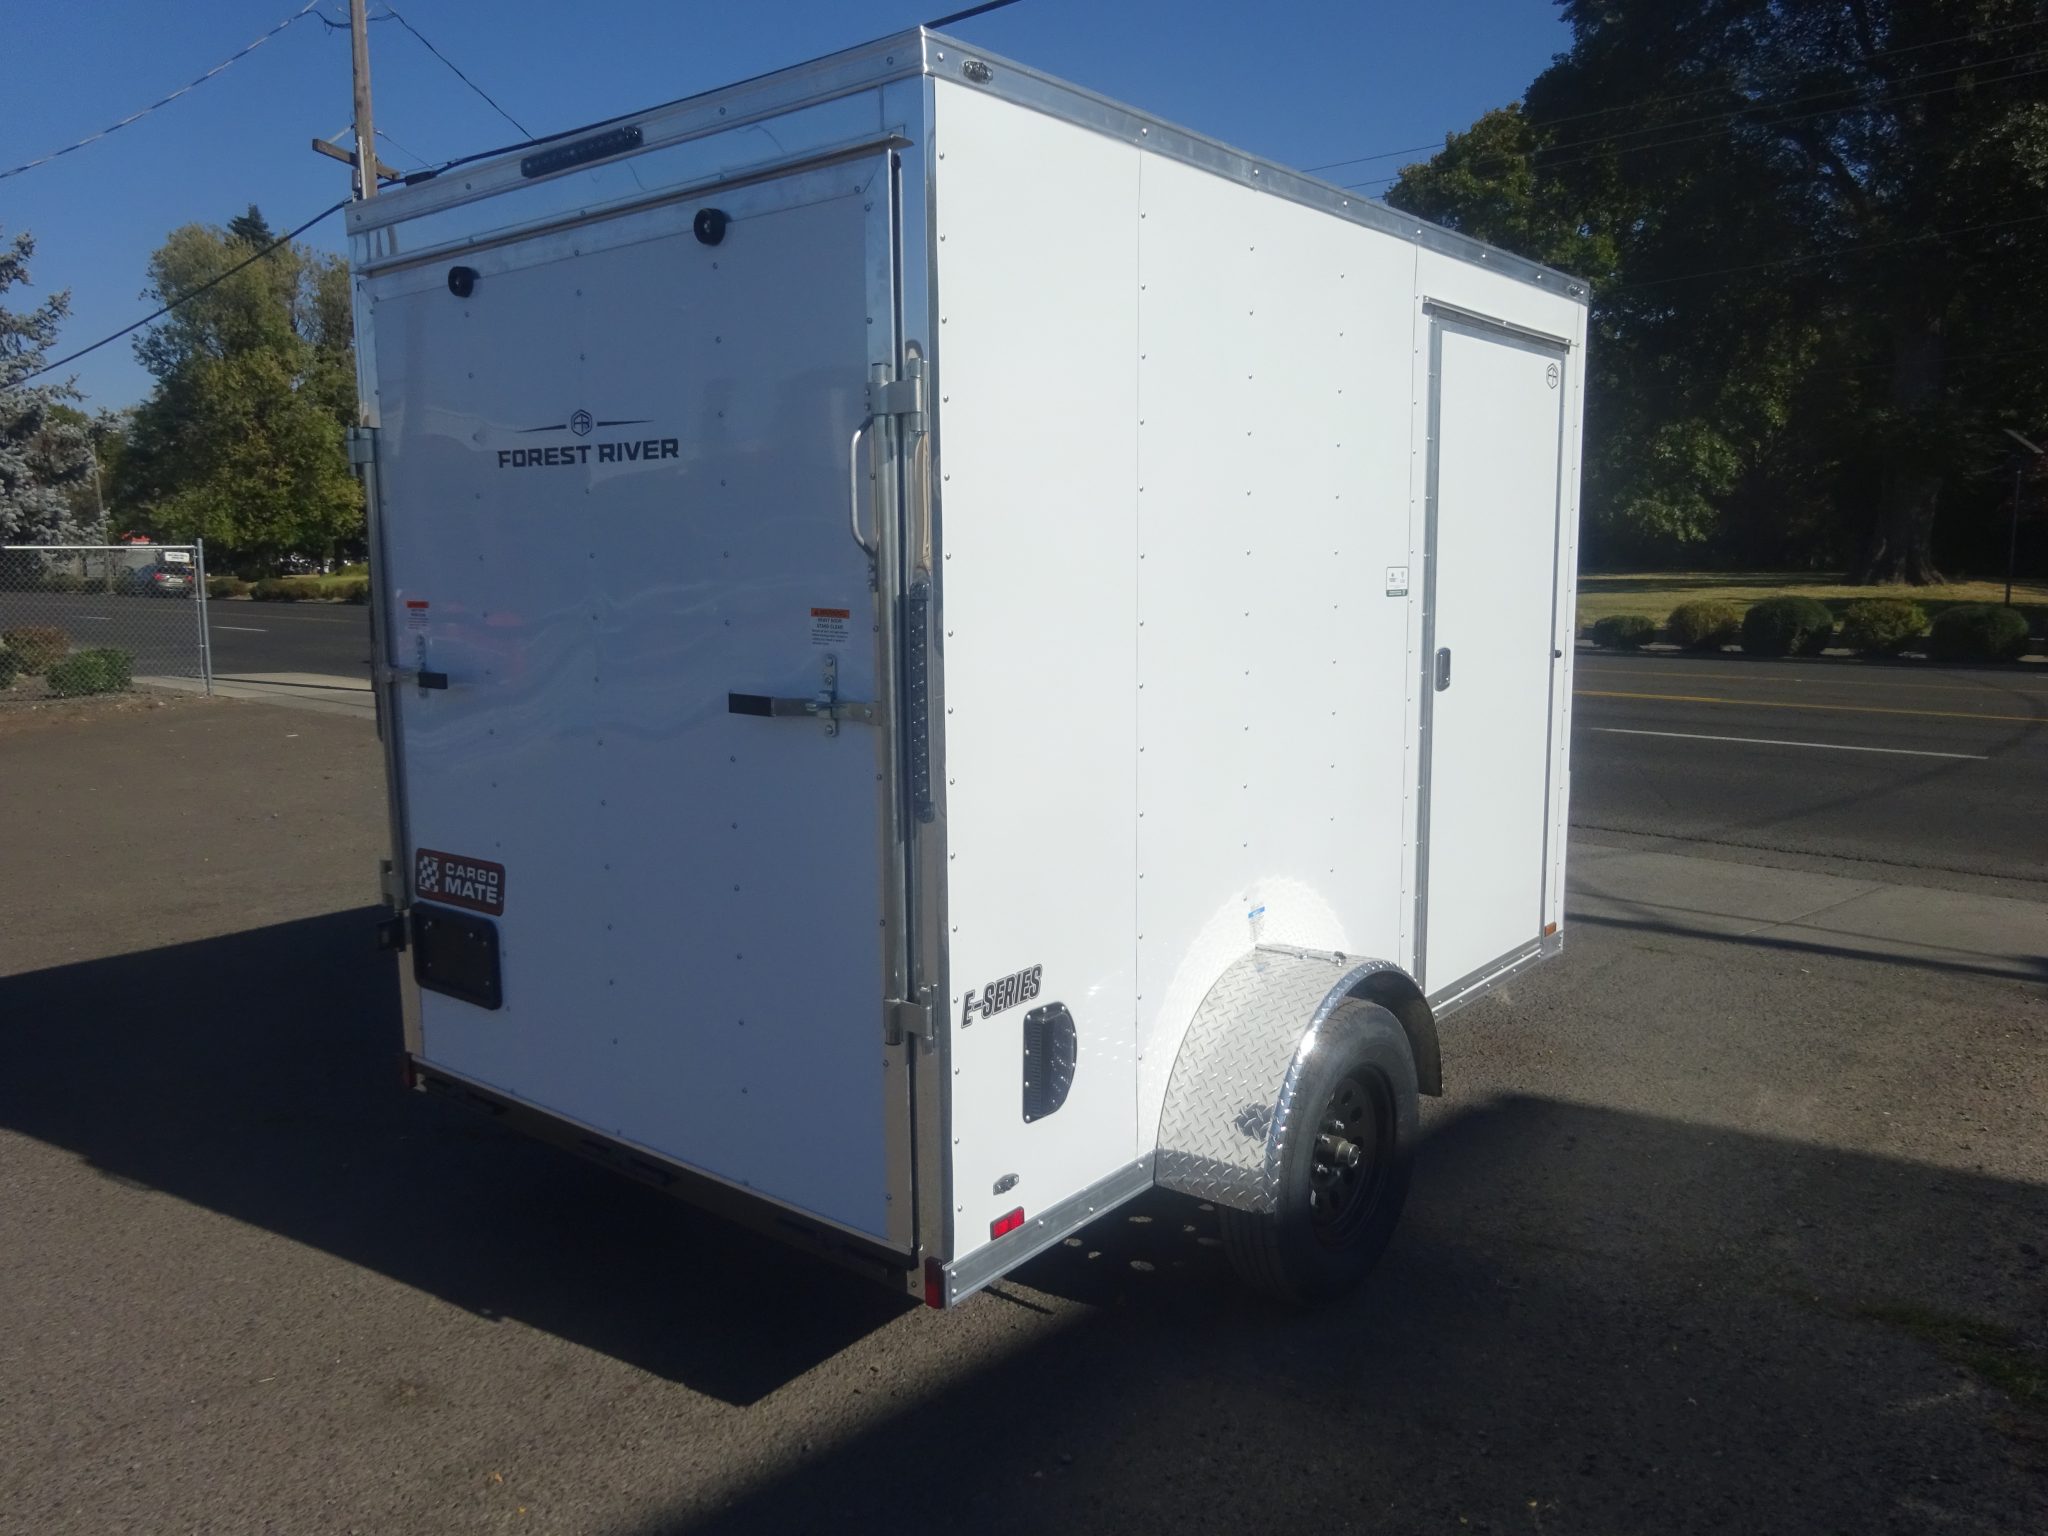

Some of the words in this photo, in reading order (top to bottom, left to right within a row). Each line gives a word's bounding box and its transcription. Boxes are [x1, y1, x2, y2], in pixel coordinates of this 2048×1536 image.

[497, 444, 592, 469] FOREST
[597, 438, 680, 463] RIVER
[445, 862, 498, 885] CARGO
[445, 876, 498, 904] MATE
[961, 964, 1043, 1029] E-SERIES
